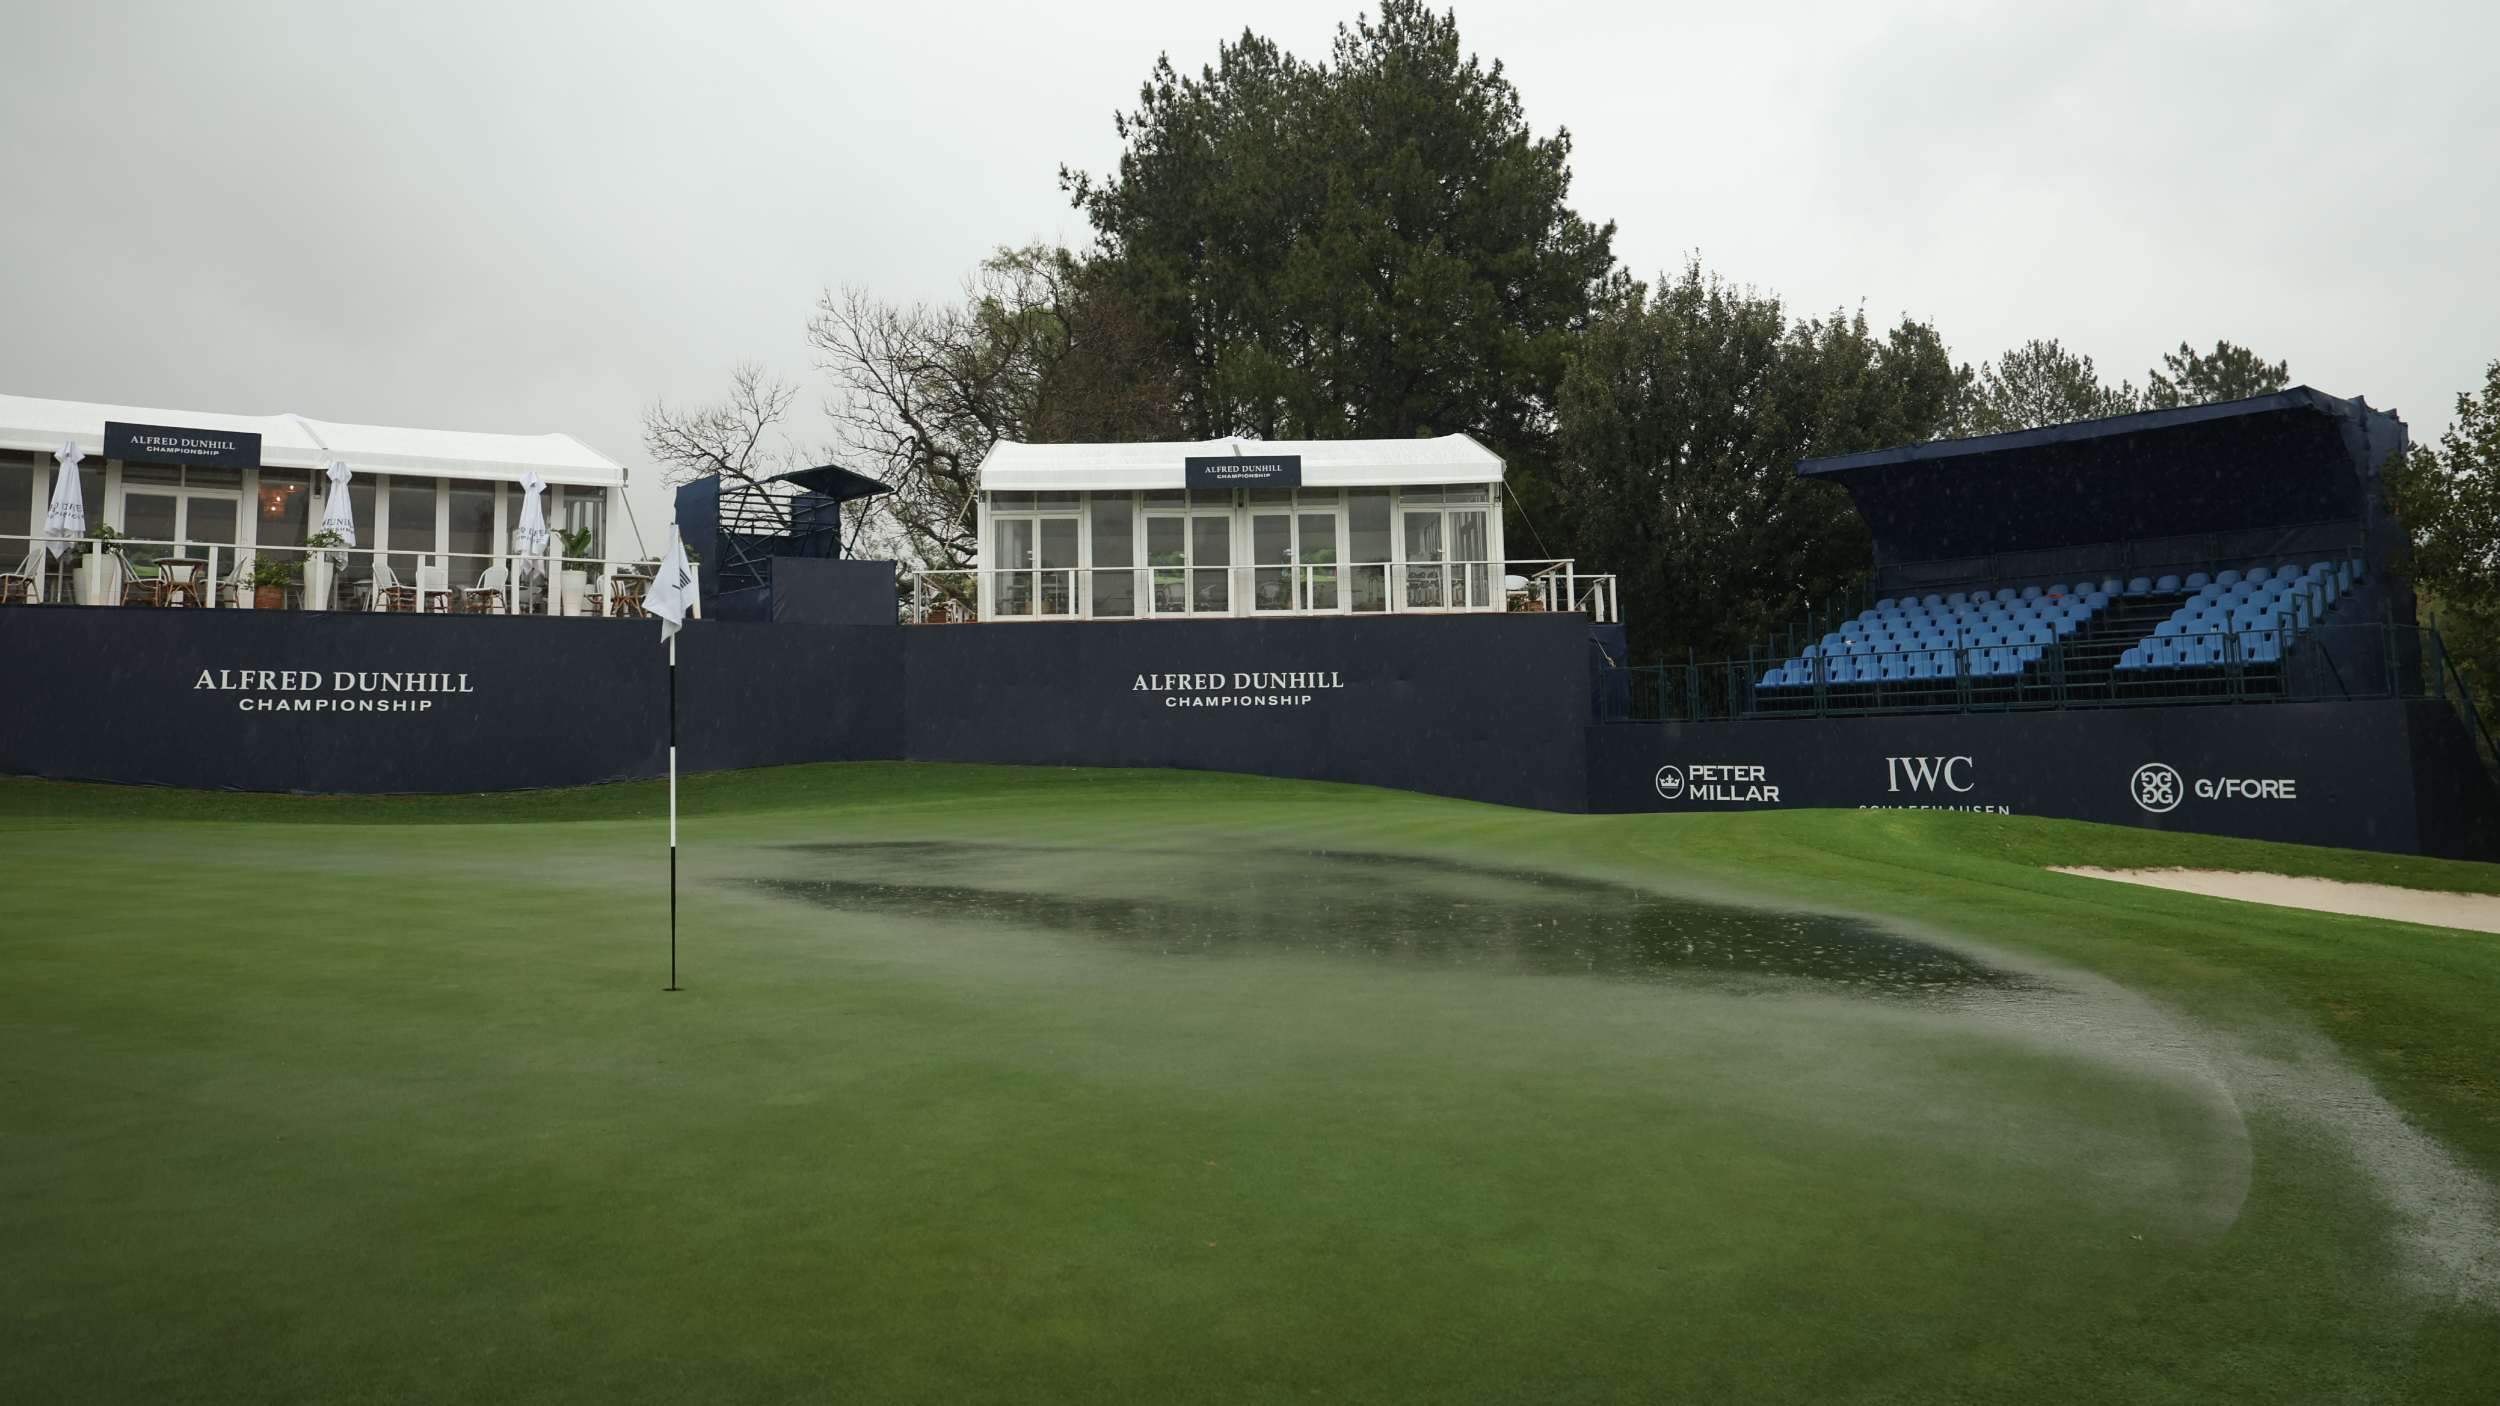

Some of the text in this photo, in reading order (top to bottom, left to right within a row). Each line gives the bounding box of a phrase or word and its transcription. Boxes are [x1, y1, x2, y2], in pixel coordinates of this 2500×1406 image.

[130, 435, 236, 450] ALFRED DUNHILL
[146, 446, 220, 456] CHAMPIONSHIP
[1205, 464, 1283, 474] ALFRED DUNHILL
[193, 669, 474, 693] ALFRED DUNHILL
[1132, 671, 1344, 691] ALFRED DUNHILL
[239, 698, 432, 712] CHAMPIONSHIP
[1165, 695, 1312, 708] CHAMPIONSHIP
[1688, 765, 1766, 782] PETER
[1885, 755, 1975, 793] IWC
[1689, 784, 1780, 802] MILLAR
[2194, 777, 2297, 800] G/FORE
